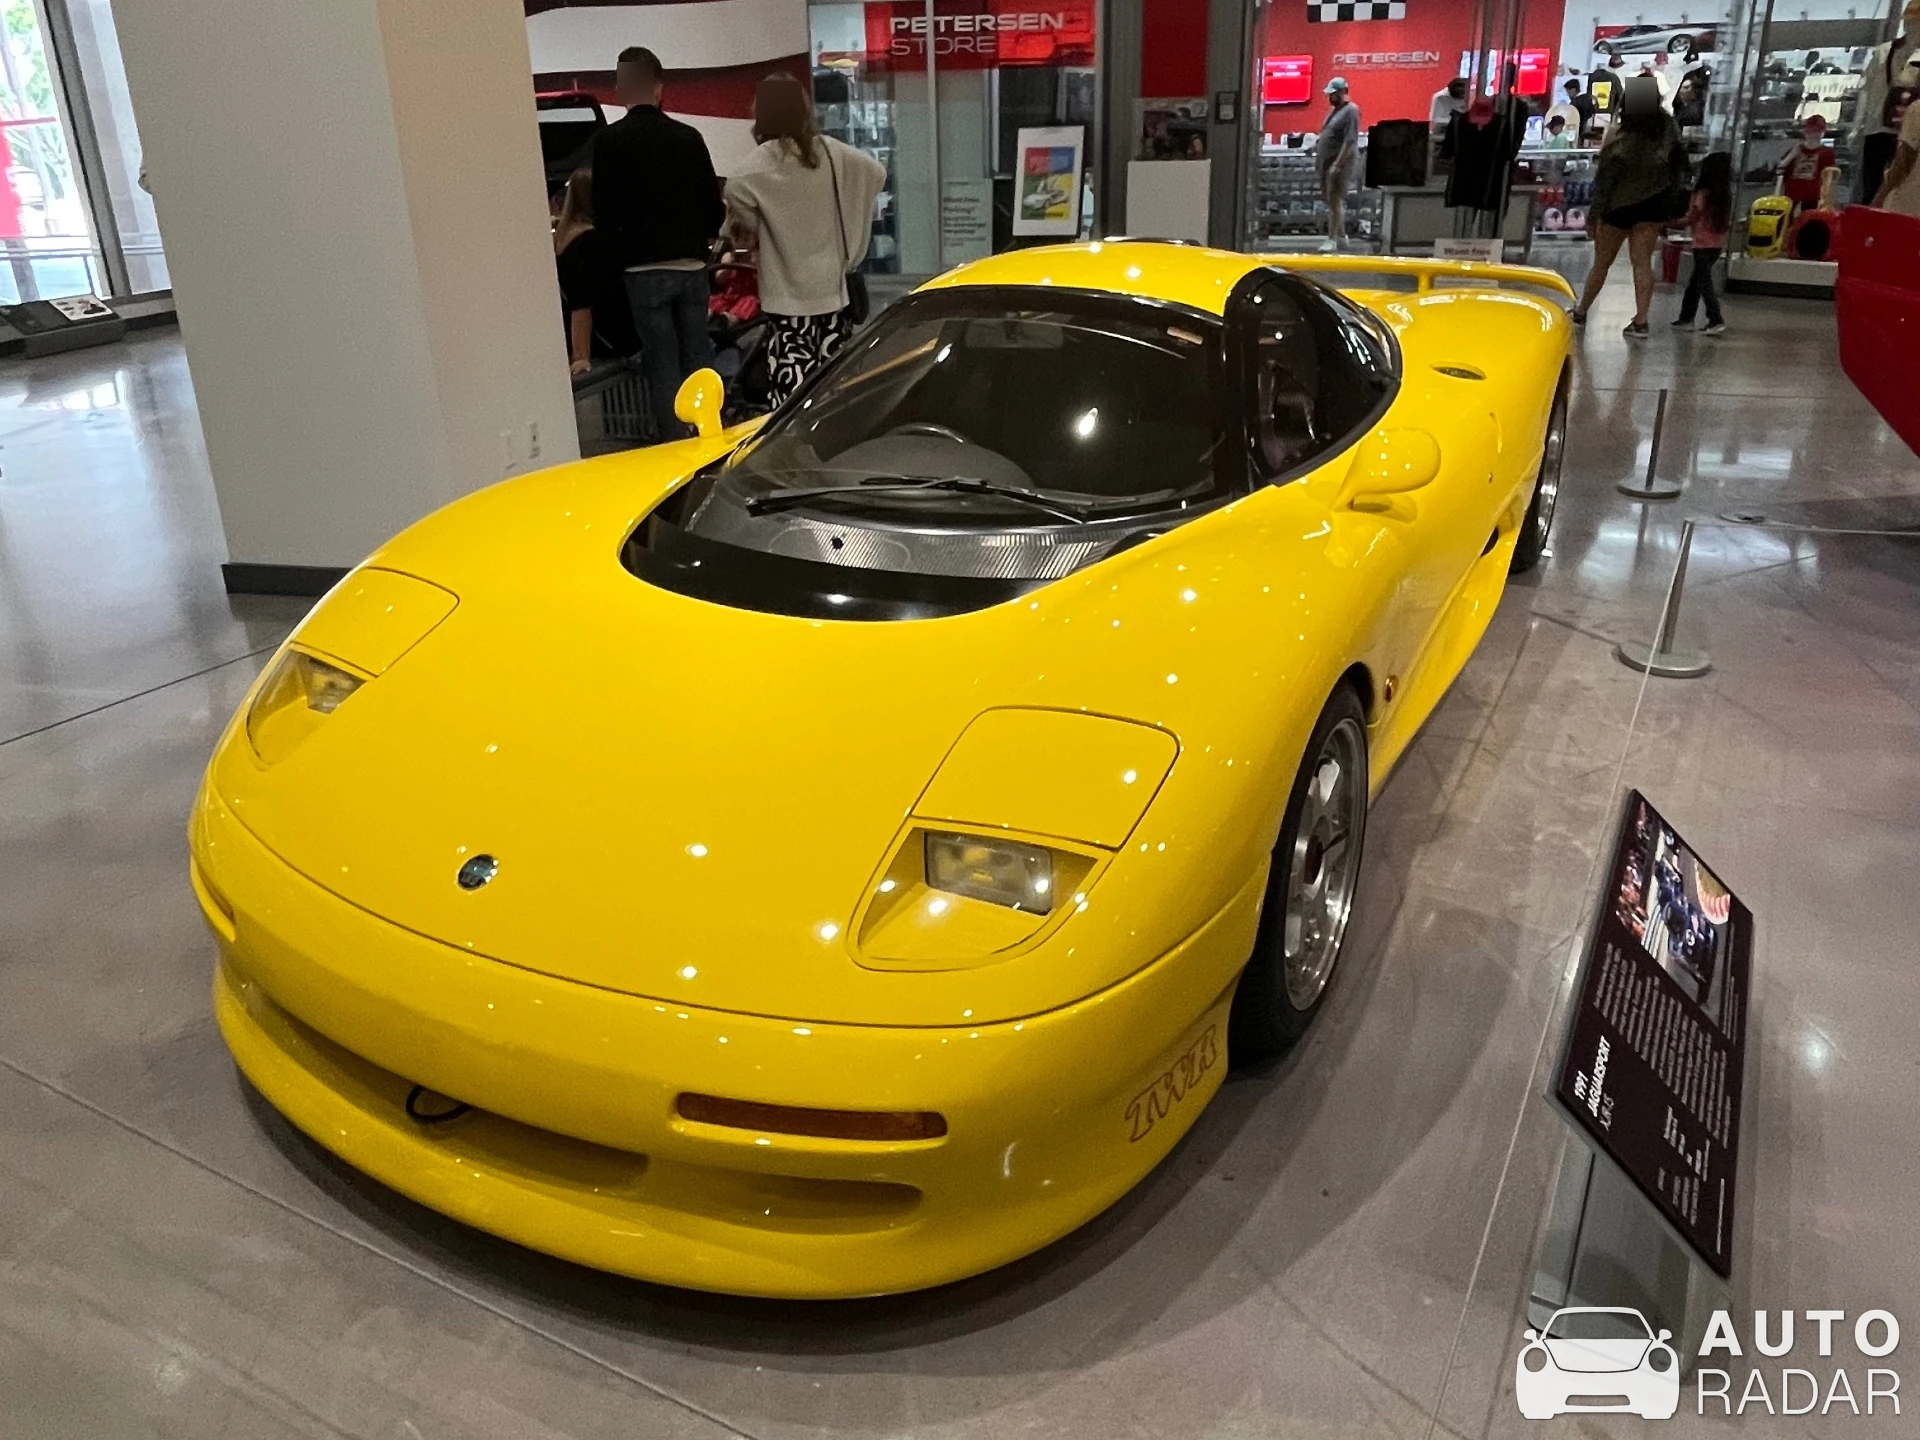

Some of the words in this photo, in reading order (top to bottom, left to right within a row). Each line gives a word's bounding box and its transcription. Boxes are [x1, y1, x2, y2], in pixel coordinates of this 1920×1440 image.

[890, 12, 1064, 35] PETERSEN
[891, 36, 997, 56] STORE
[1332, 51, 1441, 64] PETERSEN
[1574, 1070, 1588, 1100] 1991
[1587, 1035, 1611, 1117] JAGUARSPORT
